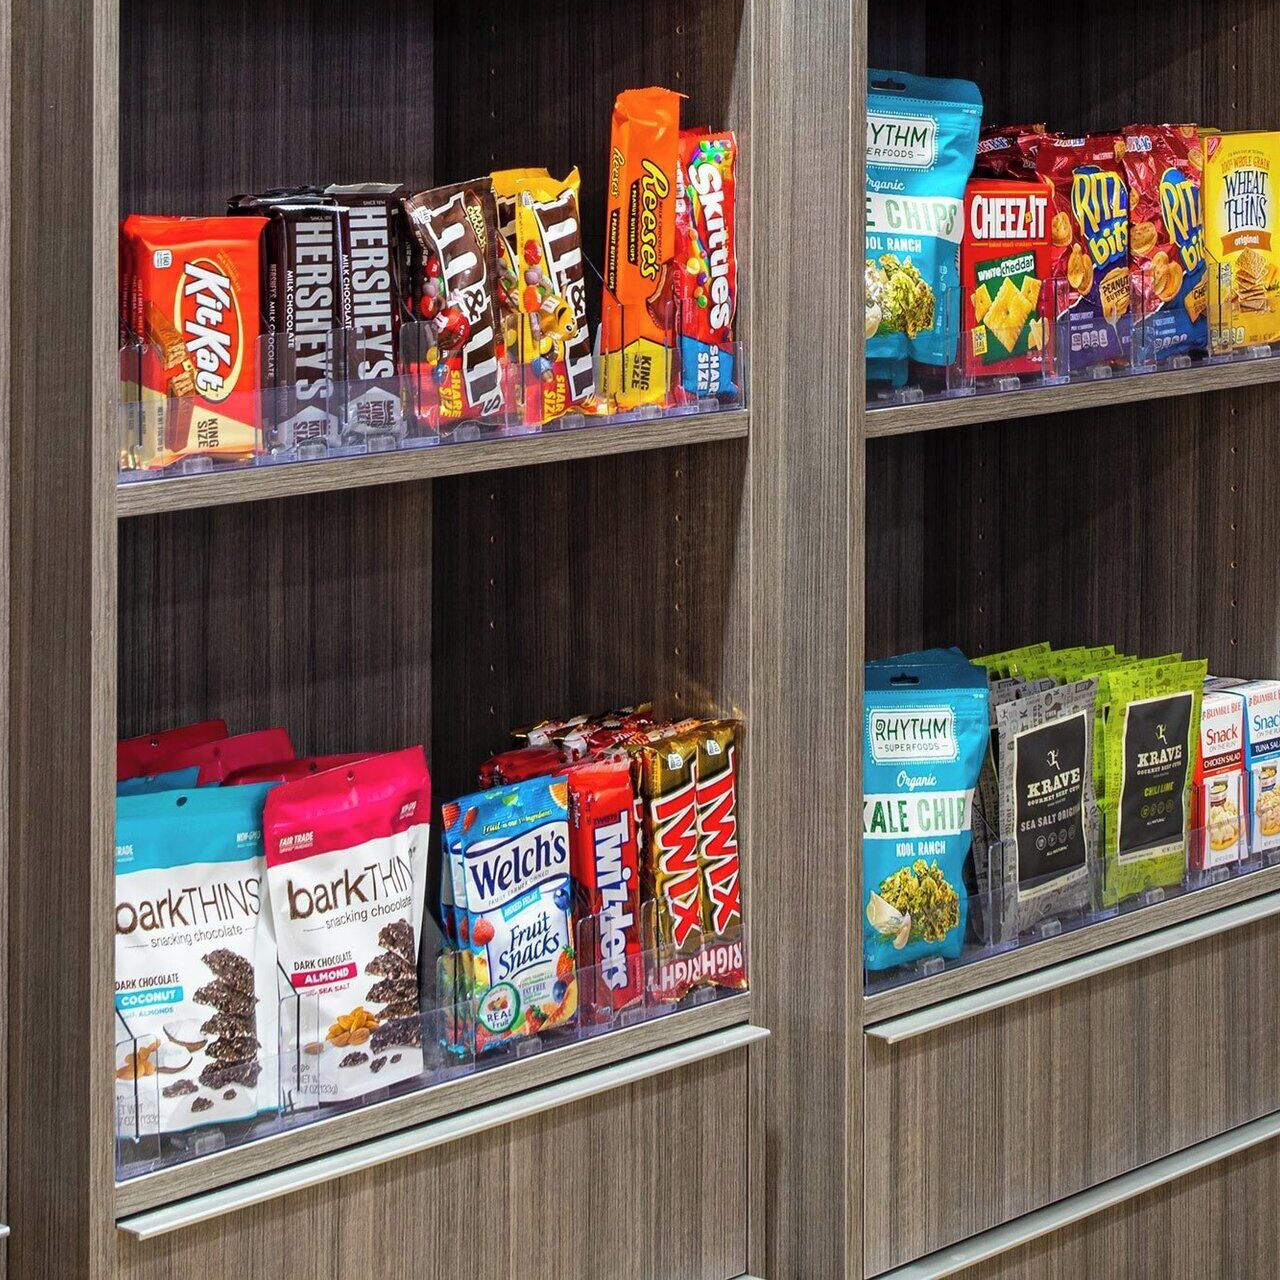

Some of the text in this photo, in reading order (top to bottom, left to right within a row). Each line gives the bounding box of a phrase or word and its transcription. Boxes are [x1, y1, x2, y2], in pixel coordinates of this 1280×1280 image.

[1224, 171, 1268, 196] WHEAT
[1225, 198, 1266, 231] THINS
[689, 164, 731, 329] Skittles
[1235, 235, 1258, 246] original
[875, 716, 948, 740] RHYTHM
[1206, 726, 1238, 743] Snack
[885, 743, 940, 752] SUPERFOODS
[1255, 741, 1269, 752] TUNA
[1203, 752, 1240, 769] CHICKEN SALAD
[897, 770, 937, 788] Organic
[1027, 768, 1081, 797] KRAVE
[470, 832, 566, 899] Welch's
[510, 914, 549, 946] Fruit
[499, 931, 560, 971] Snacks
[304, 968, 351, 985] ALMOND
[121, 991, 177, 1006] COCONUT
